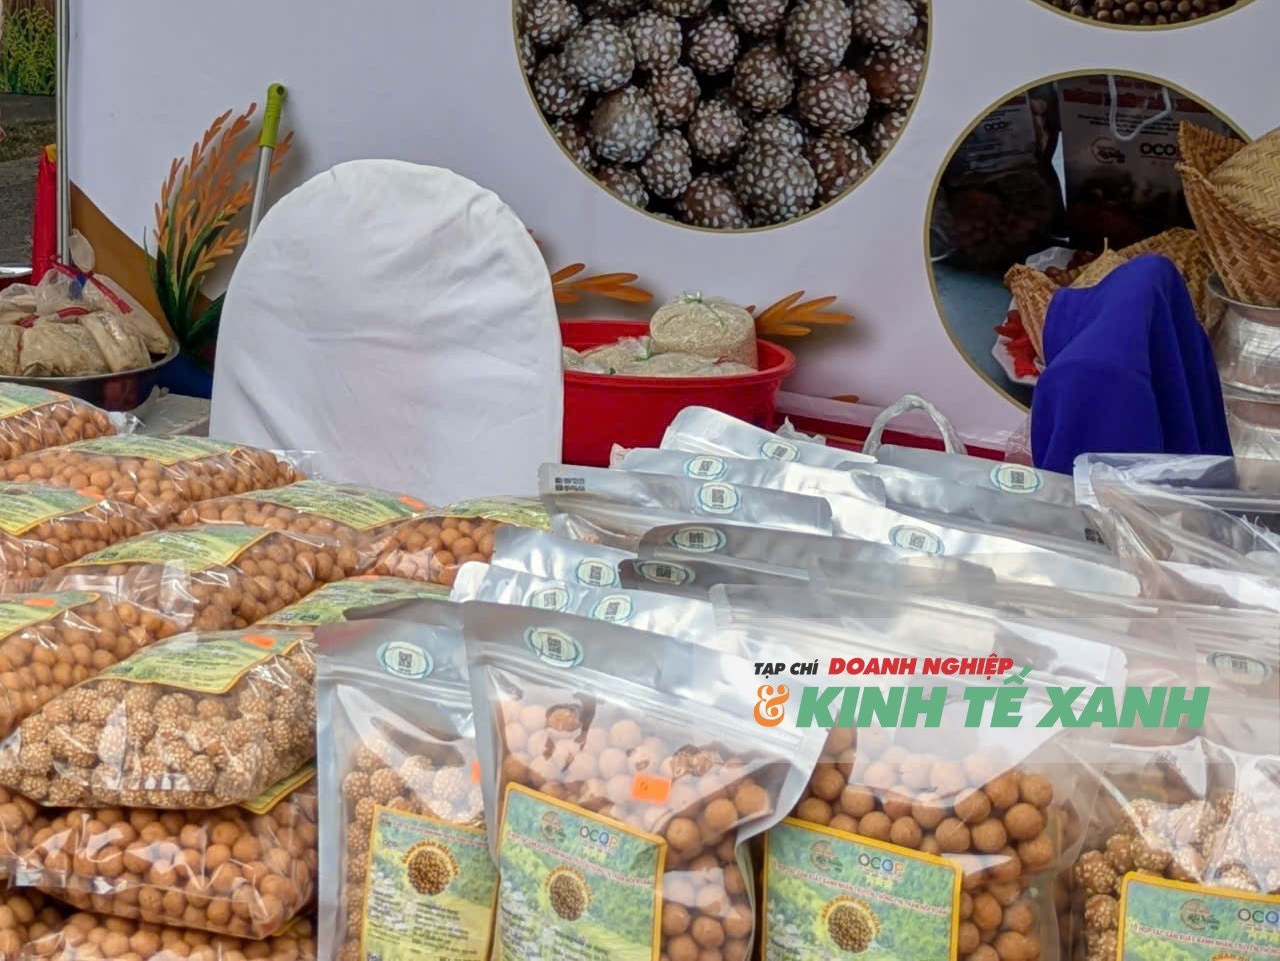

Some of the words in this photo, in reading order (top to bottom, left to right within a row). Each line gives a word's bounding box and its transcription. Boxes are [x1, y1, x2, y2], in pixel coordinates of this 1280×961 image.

[1140, 142, 1177, 156] OCO
[580, 825, 619, 847] OCOP
[858, 853, 905, 874] OCOP
[1237, 908, 1280, 924] OCO
